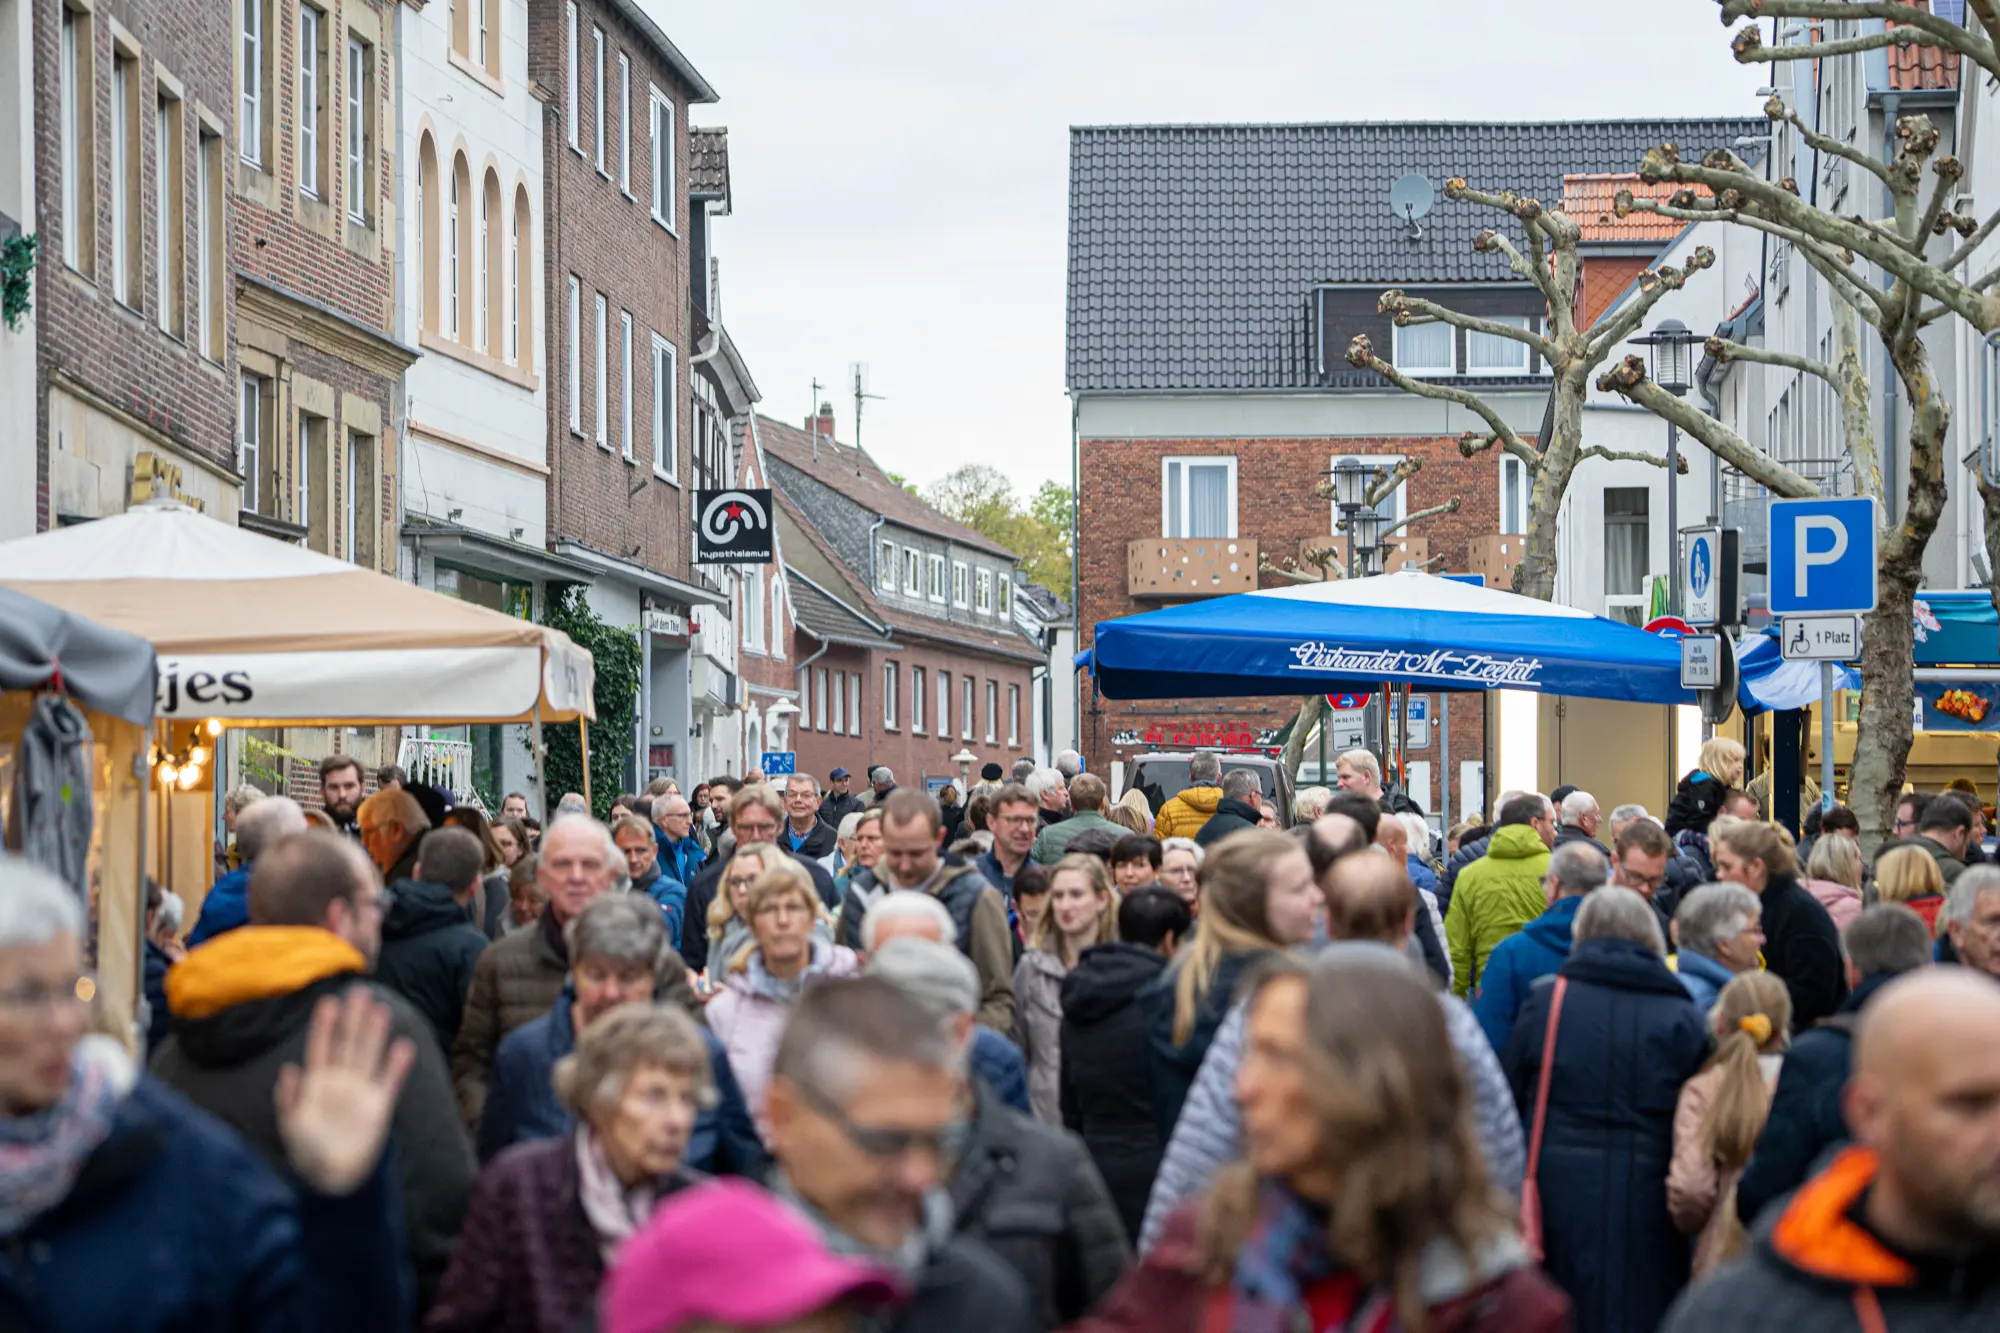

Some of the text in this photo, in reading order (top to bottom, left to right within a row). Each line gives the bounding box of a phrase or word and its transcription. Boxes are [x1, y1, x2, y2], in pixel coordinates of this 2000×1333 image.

[700, 549, 770, 559] hypothalamus
[1794, 514, 1849, 598] P
[1692, 602, 1707, 618] ZONE
[1815, 630, 1851, 645] 1 Platz
[1296, 641, 1400, 671] Vishandel
[1404, 649, 1454, 675] M.
[156, 662, 254, 713] jes
